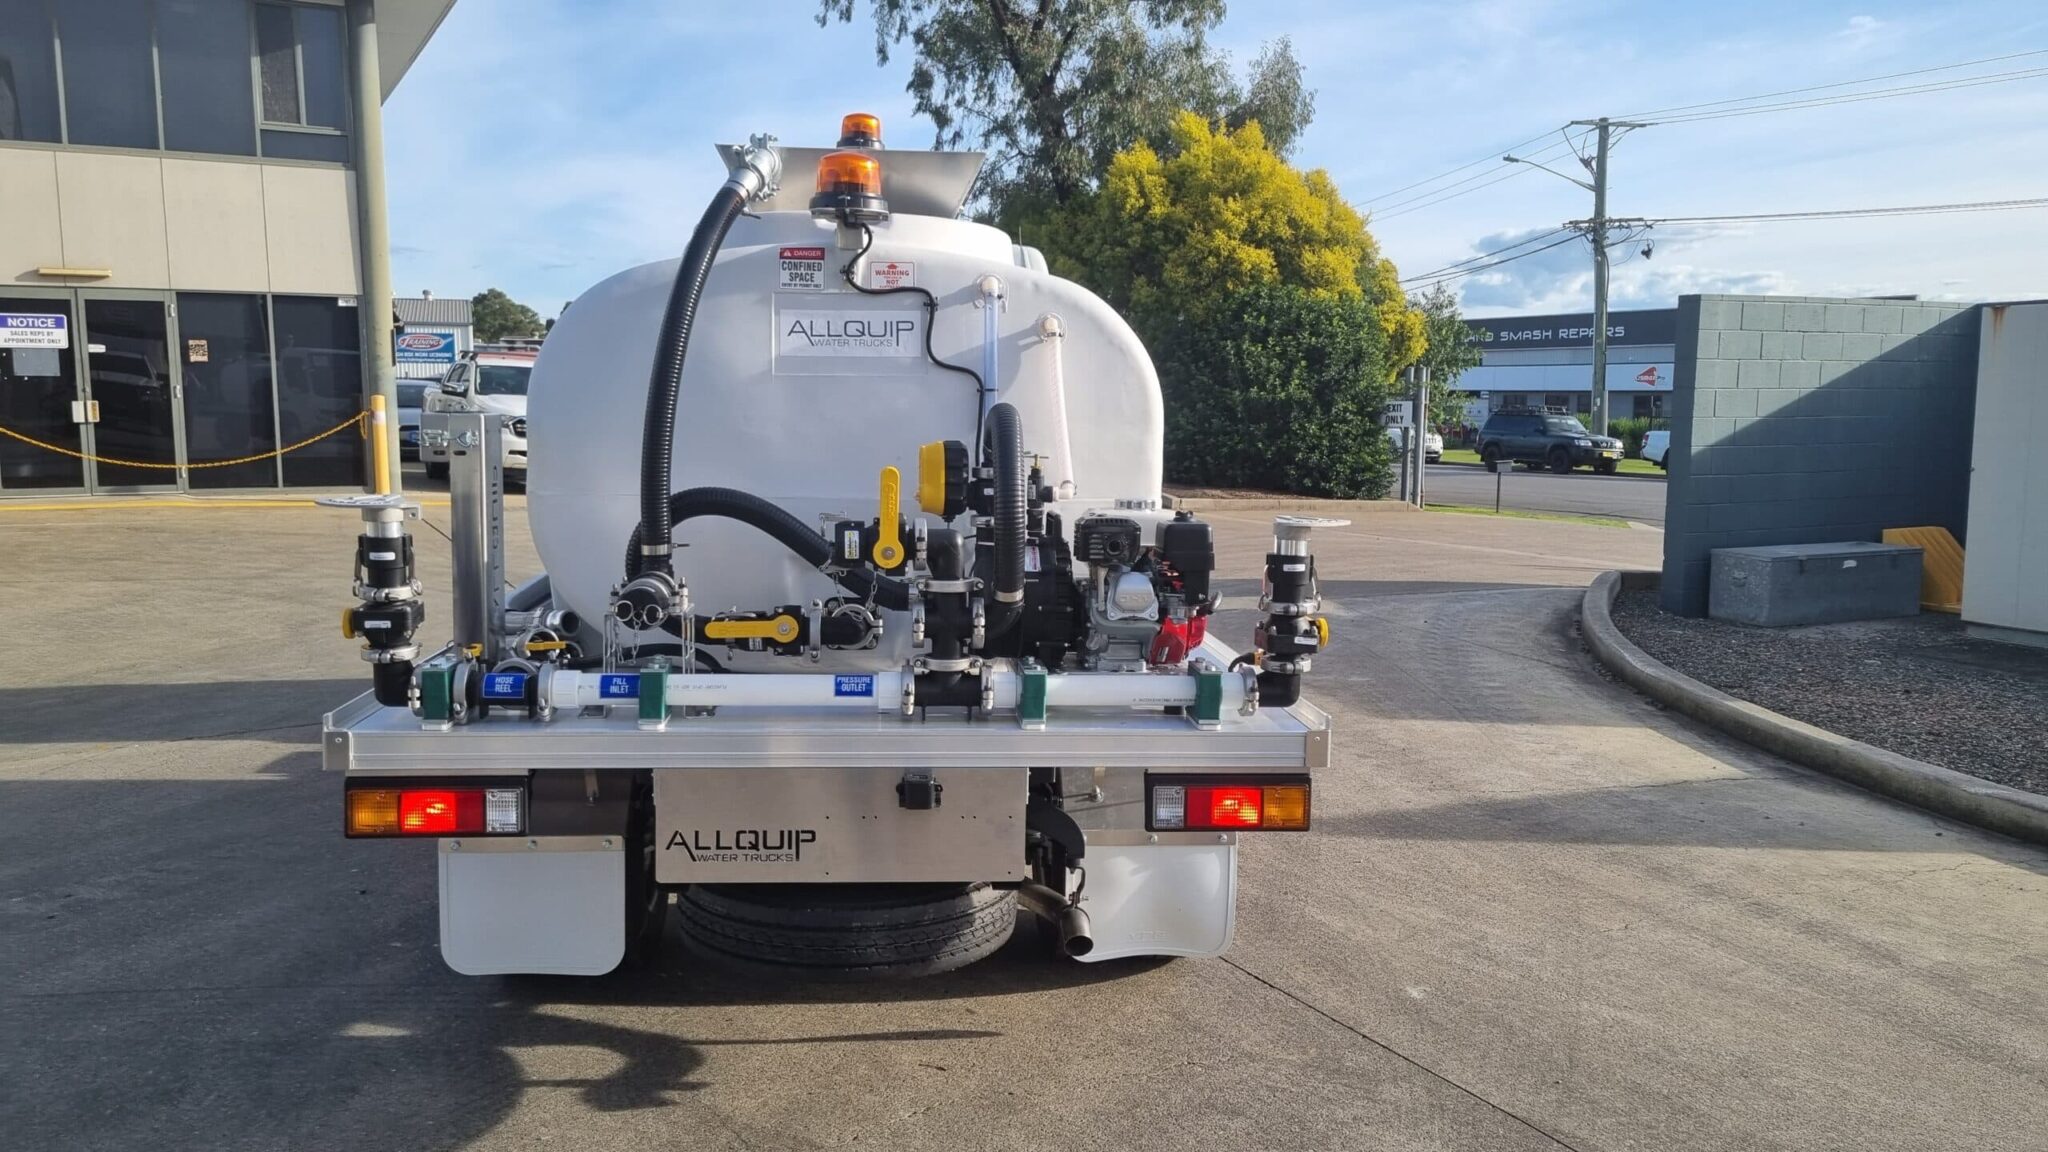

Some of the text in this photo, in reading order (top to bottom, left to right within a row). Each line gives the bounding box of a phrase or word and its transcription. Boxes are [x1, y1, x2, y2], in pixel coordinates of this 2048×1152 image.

[781, 260, 823, 272] CONFINED
[788, 272, 815, 282] SPACE
[7, 317, 57, 328] NOTICE
[786, 320, 915, 347] ALLQUIP
[1500, 328, 1552, 341] SMASH
[1558, 326, 1626, 340] REPARS
[814, 339, 893, 348] WATER TRUCKS
[1386, 403, 1403, 413] EXIT
[1385, 415, 1405, 425] ONLY
[495, 676, 514, 684] HOSE
[612, 677, 627, 685] FILL
[836, 675, 871, 684] PRESSURE
[494, 684, 513, 693] REEL
[609, 685, 630, 694] INLET
[841, 683, 866, 692] OUTLET
[665, 830, 817, 862] ALLQUIP
[696, 853, 794, 862] WATER TRUCKS
